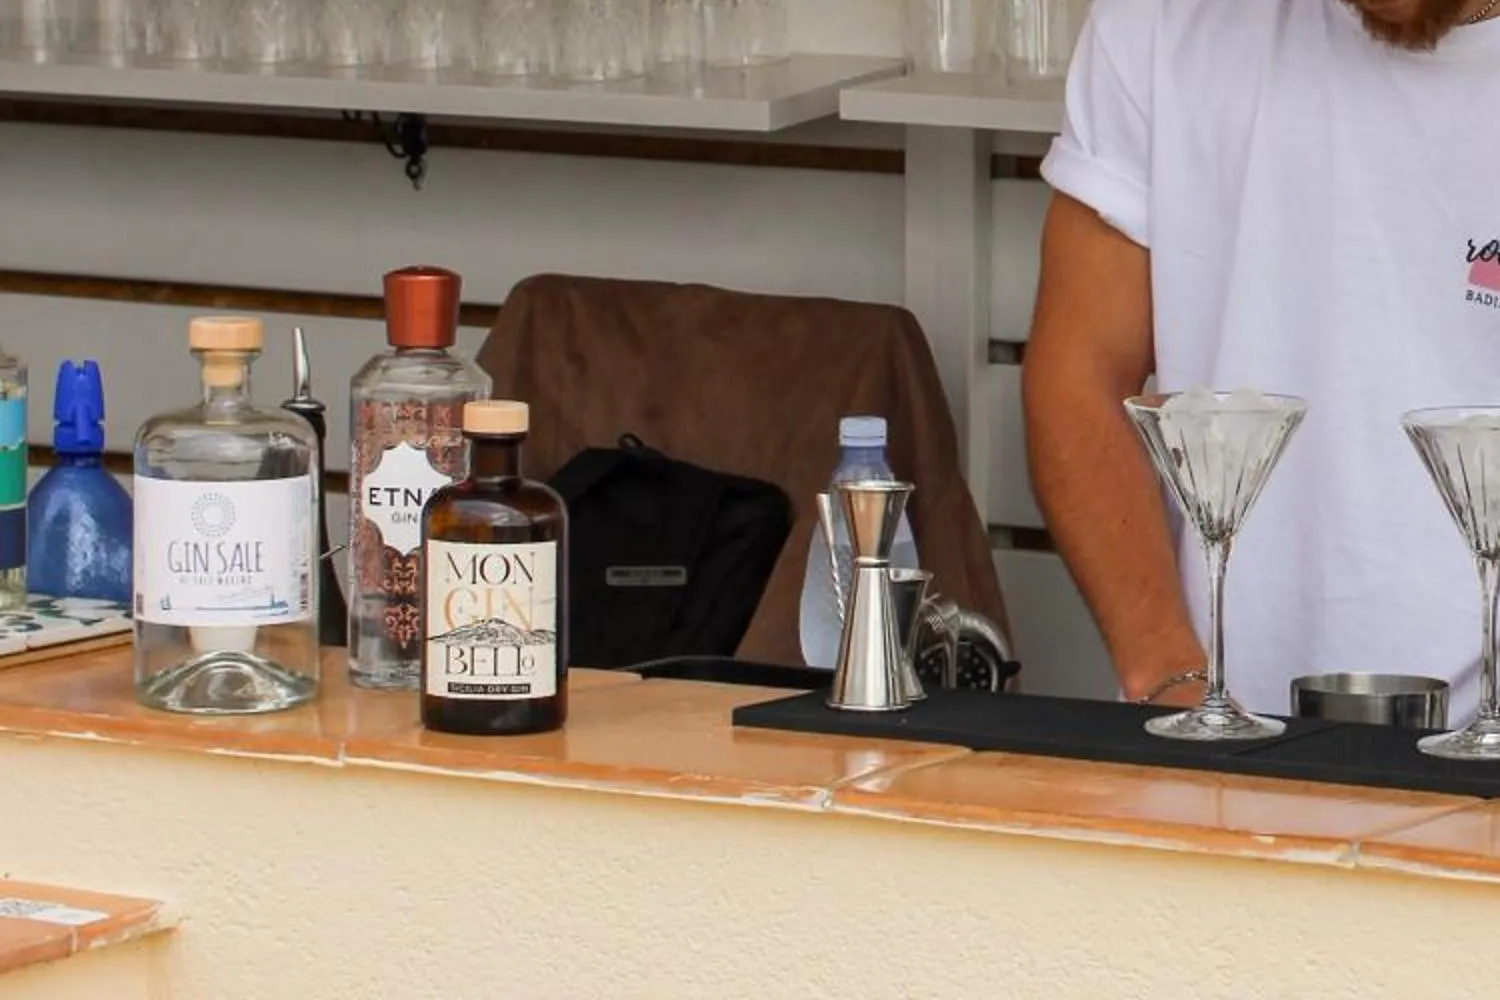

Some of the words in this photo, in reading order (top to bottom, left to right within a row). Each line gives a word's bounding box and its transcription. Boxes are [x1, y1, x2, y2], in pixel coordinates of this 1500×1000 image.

[391, 511, 418, 523] GIN
[167, 540, 209, 573] GIN
[216, 540, 265, 574] SALE
[445, 551, 535, 585] MON
